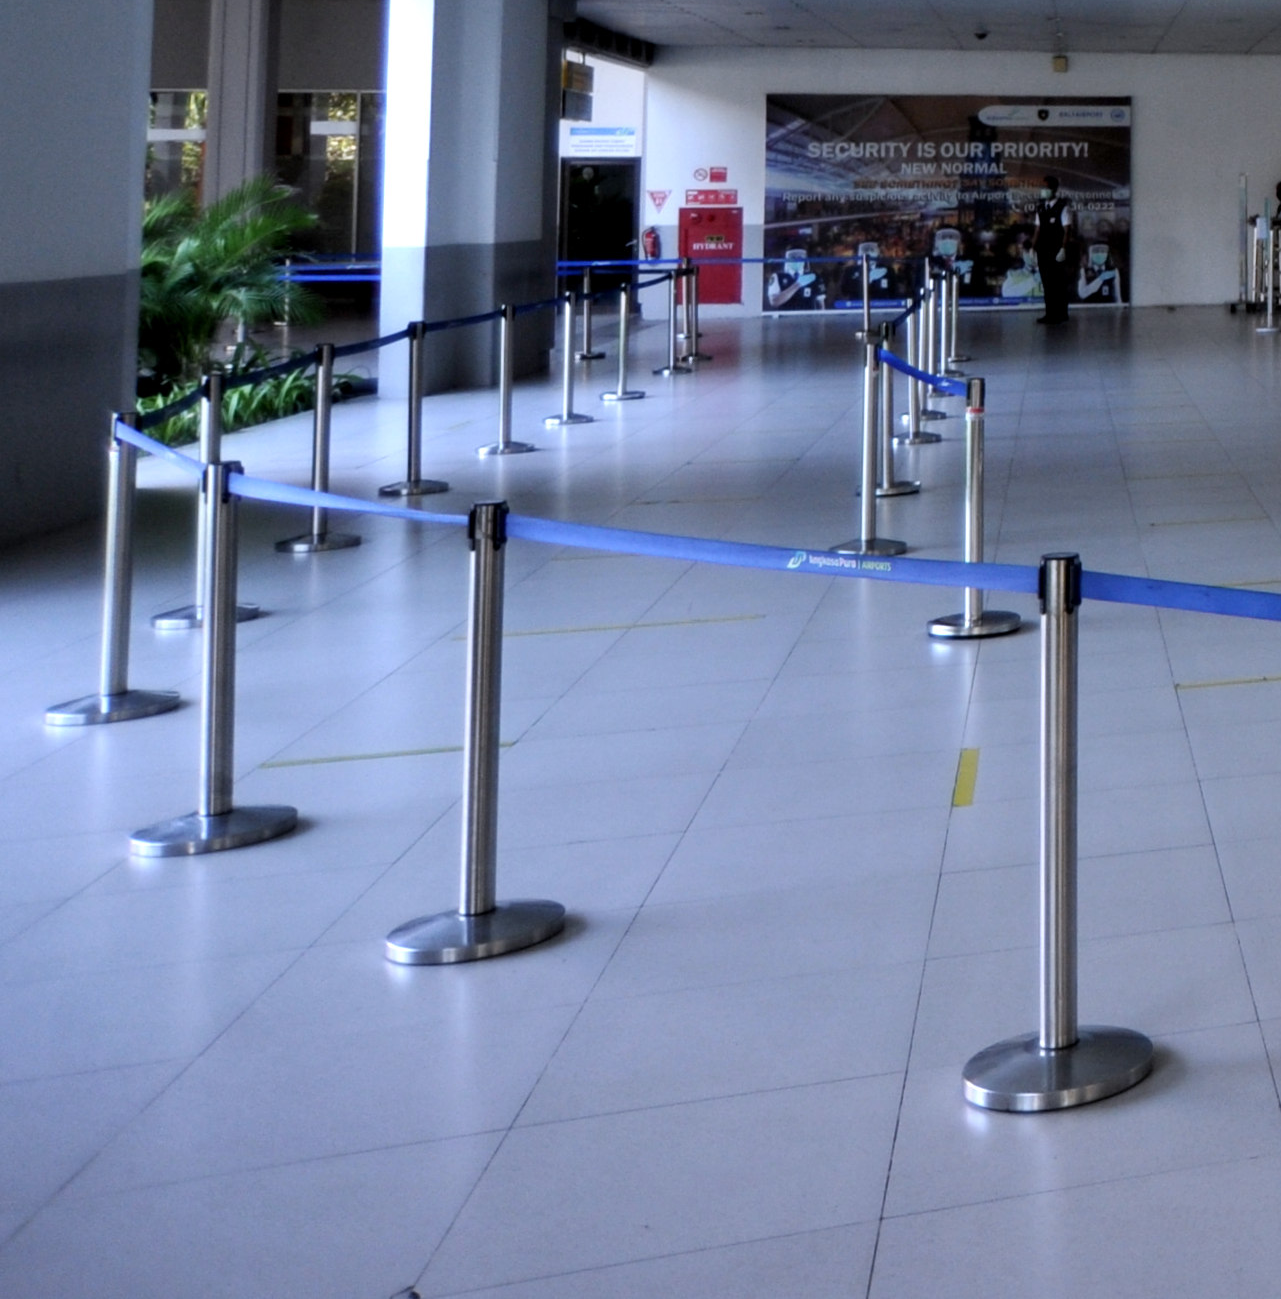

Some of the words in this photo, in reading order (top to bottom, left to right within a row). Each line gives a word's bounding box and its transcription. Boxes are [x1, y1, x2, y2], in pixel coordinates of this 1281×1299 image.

[807, 141, 911, 159] SECURITY
[917, 141, 936, 158] IS
[940, 141, 983, 158] OUR
[990, 141, 1089, 158] PRIORITY!
[901, 162, 937, 175] NEW
[940, 162, 1007, 175] NORMAL
[692, 242, 734, 251] HYDRANT
